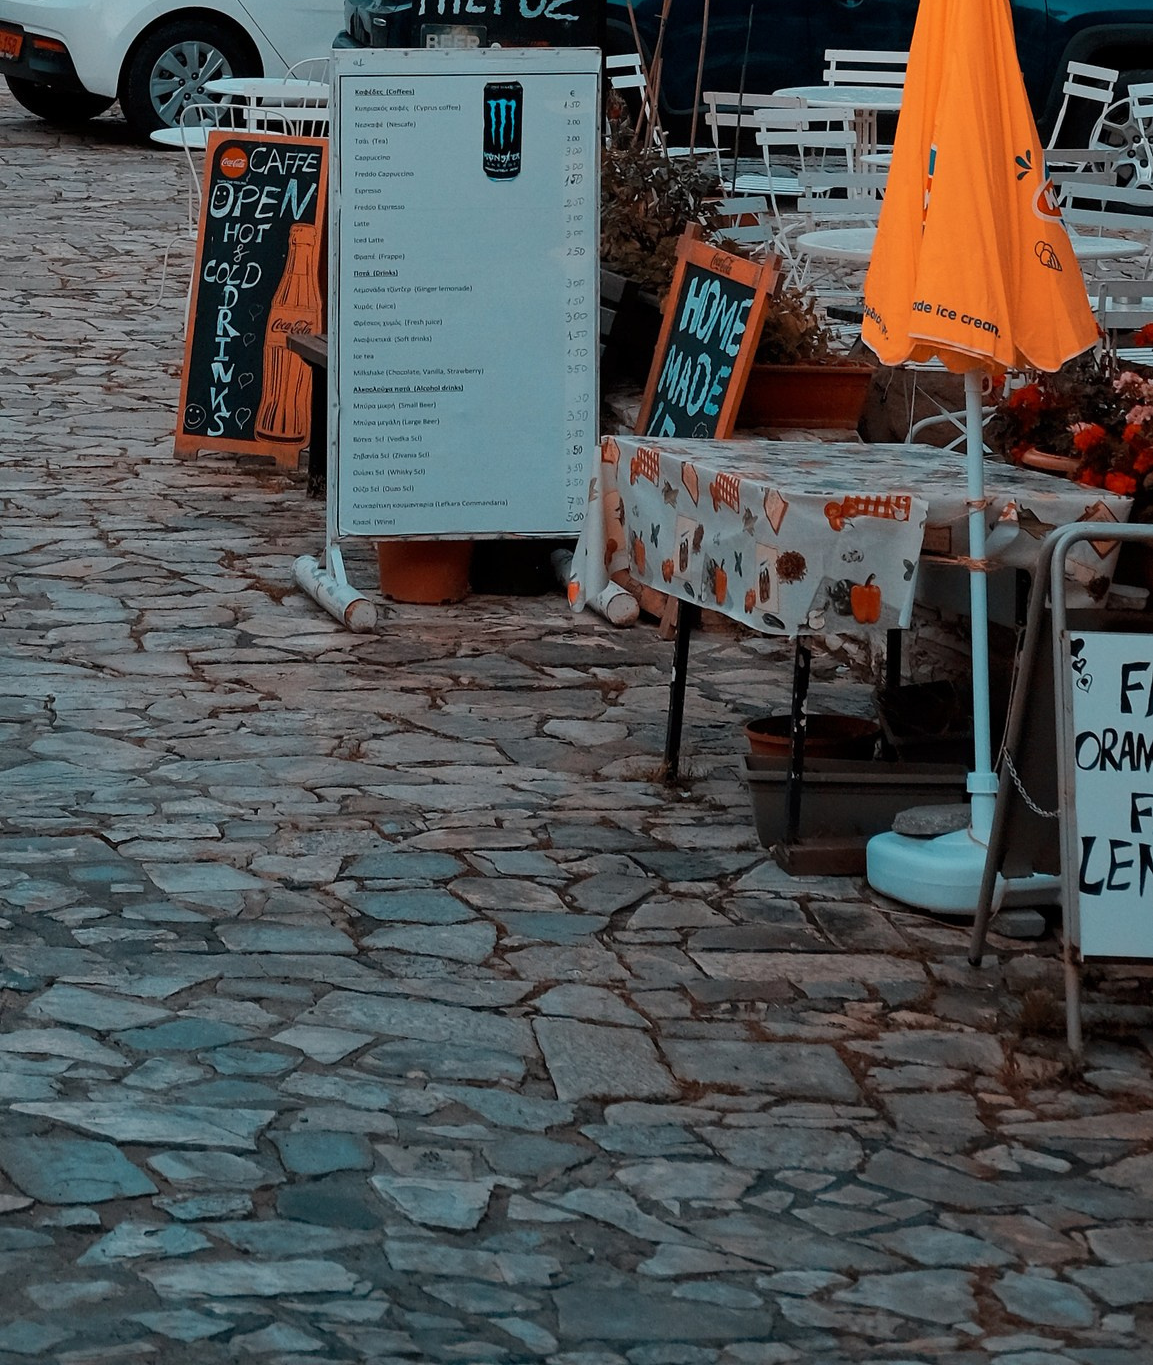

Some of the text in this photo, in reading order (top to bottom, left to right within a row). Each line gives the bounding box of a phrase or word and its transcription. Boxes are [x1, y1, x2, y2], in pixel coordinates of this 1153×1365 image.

[386, 88, 415, 96] (Coffees)
[413, 104, 438, 112] (Cyprus
[386, 121, 417, 129] (Nescafe)
[250, 148, 320, 175] CAFFE
[354, 154, 391, 162] Cappuccino
[210, 178, 317, 220] OPEN
[224, 222, 273, 243] HOT
[378, 253, 405, 261] (Frappe)
[204, 259, 262, 288] COLD
[372, 269, 399, 277] (Drinks)
[679, 276, 754, 357] HOME
[936, 304, 957, 321] ice
[422, 368, 446, 376] Vanilla,
[447, 368, 484, 376] Strawberry)
[658, 344, 732, 417] MADE
[401, 419, 421, 427] (Large
[435, 500, 461, 508] (Lefkara
[461, 499, 509, 507] Commandaria)
[374, 518, 396, 526] (Wine)
[1120, 662, 1153, 714] F
